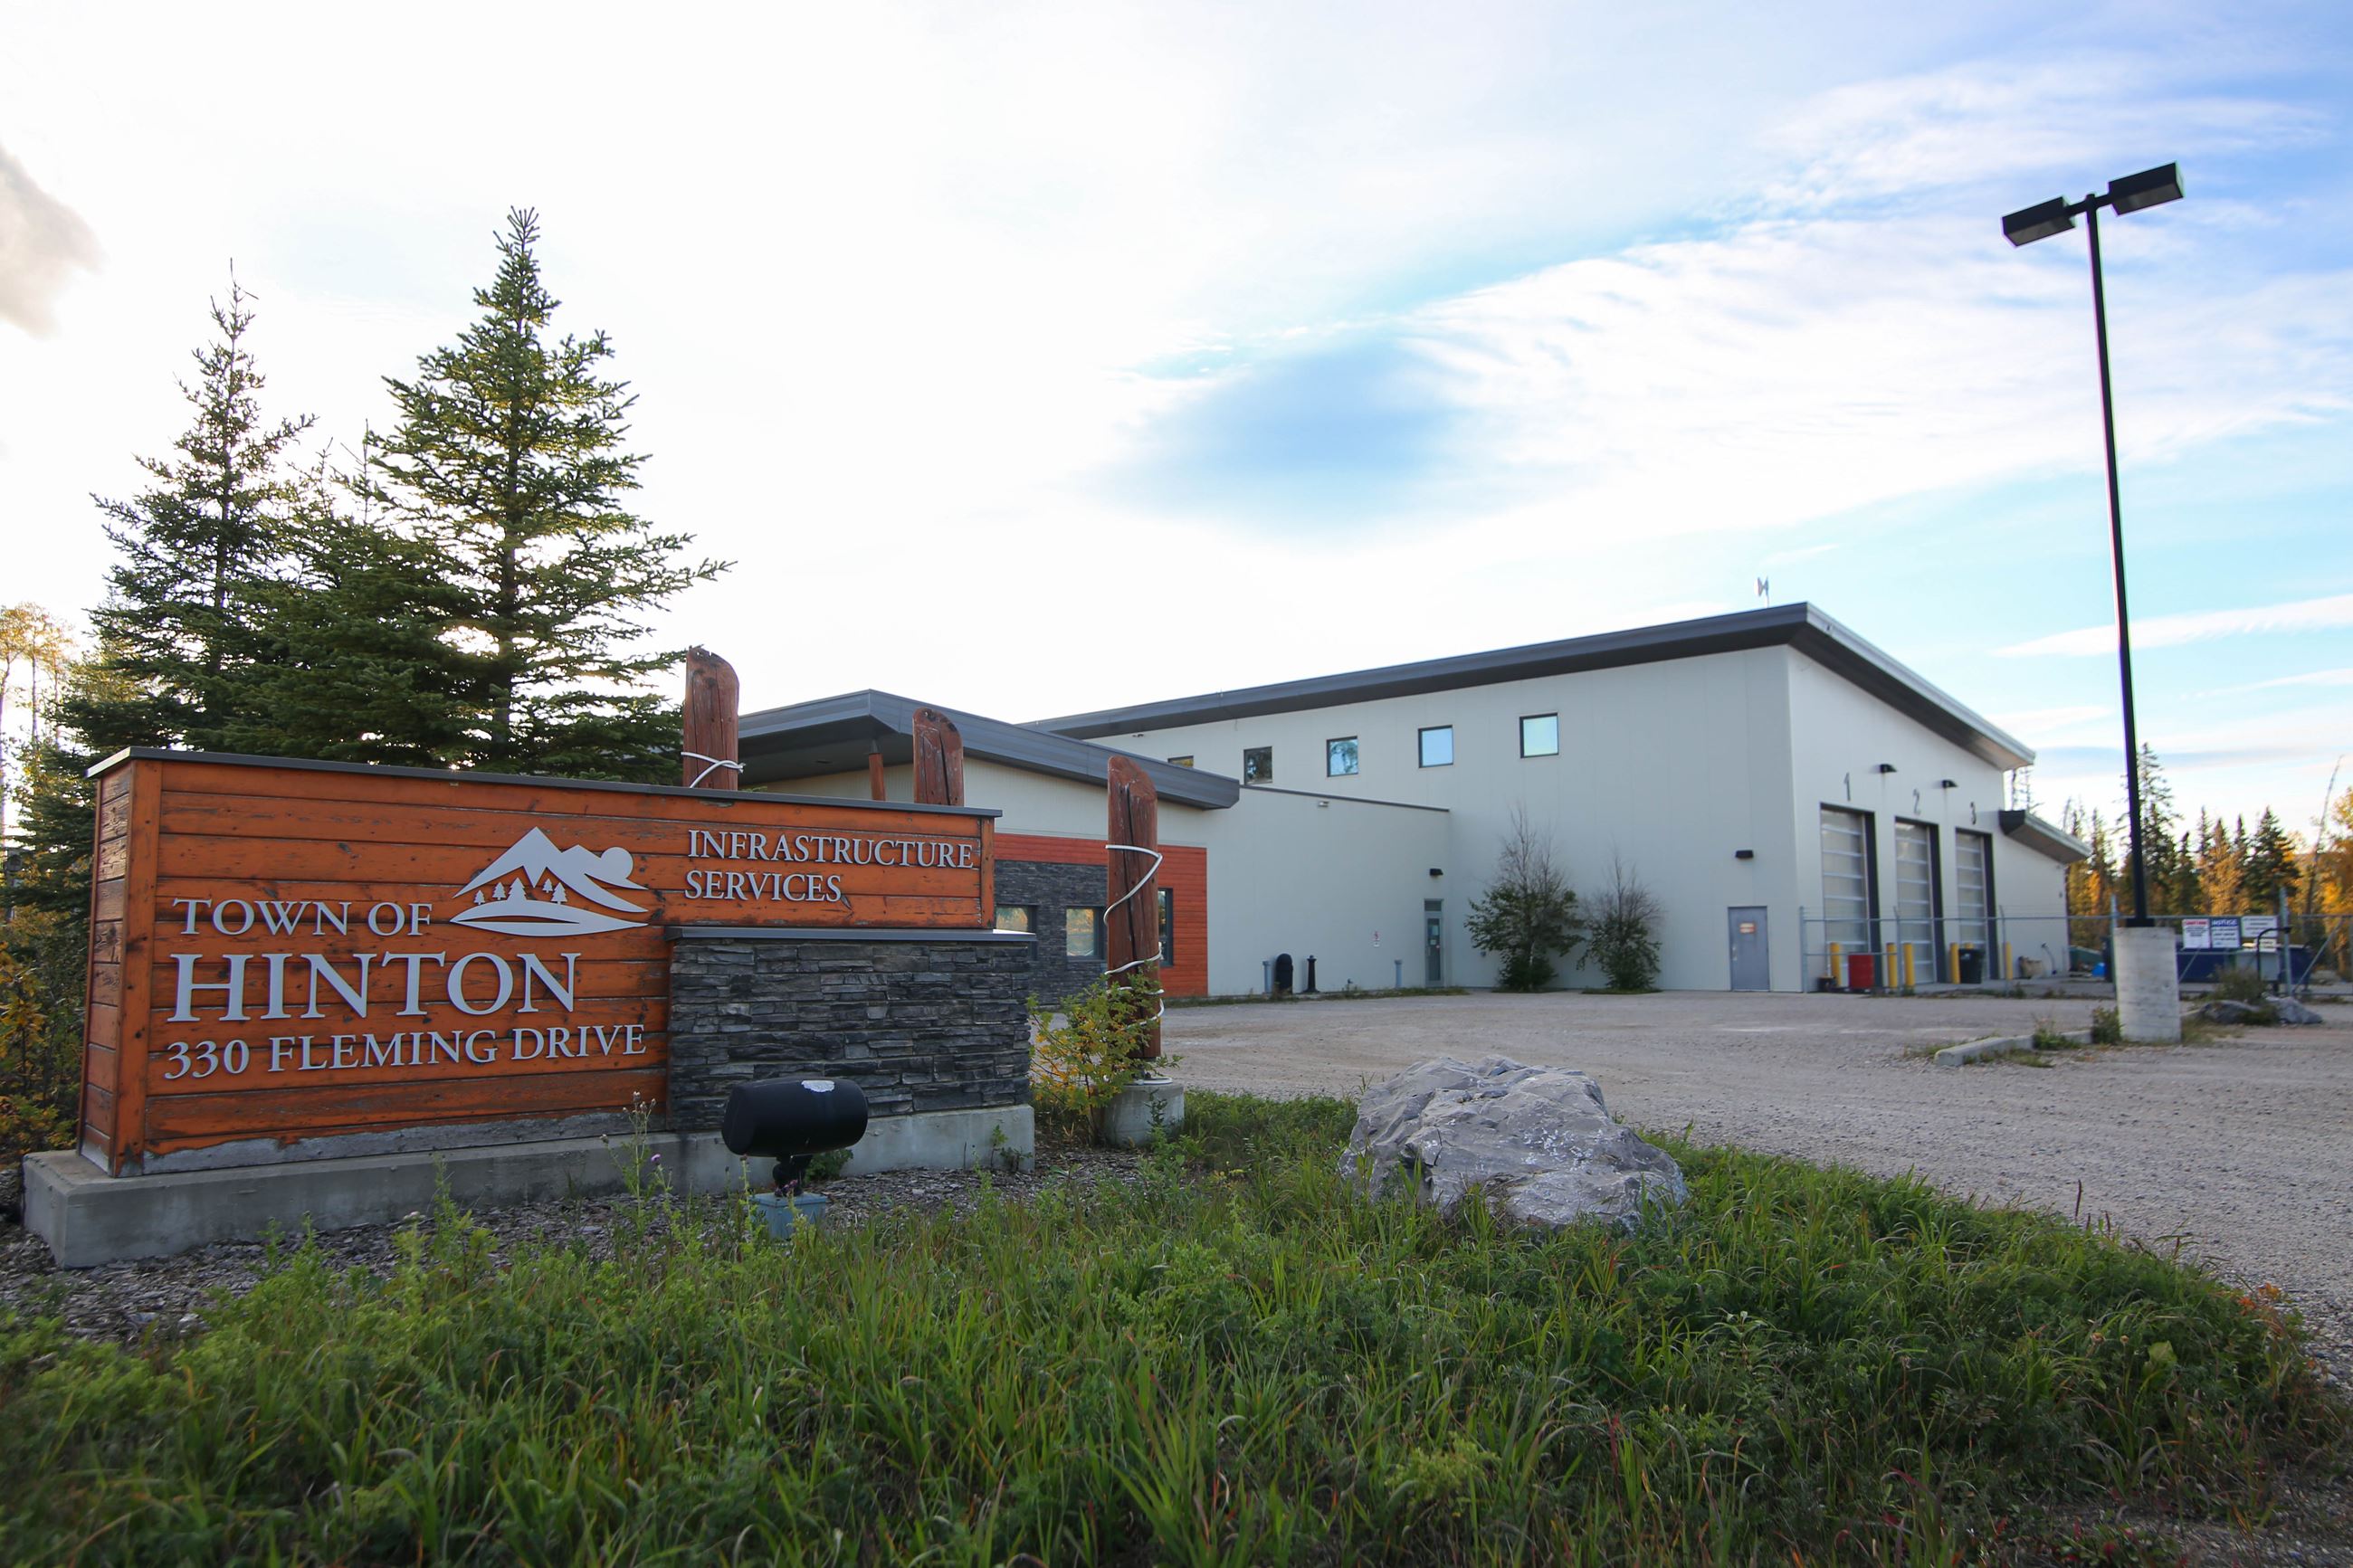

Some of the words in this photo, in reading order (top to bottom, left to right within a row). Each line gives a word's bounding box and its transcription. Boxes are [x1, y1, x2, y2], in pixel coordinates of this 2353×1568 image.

[688, 829, 974, 870] INFRASTRUCTURE
[684, 870, 842, 903] SERVICES
[172, 897, 351, 936] TOWN
[367, 902, 433, 937] OF
[167, 950, 581, 1023] HINTON
[164, 1038, 251, 1080] 330
[268, 1030, 497, 1073] FLEMING
[510, 1023, 647, 1061] DRIVE
